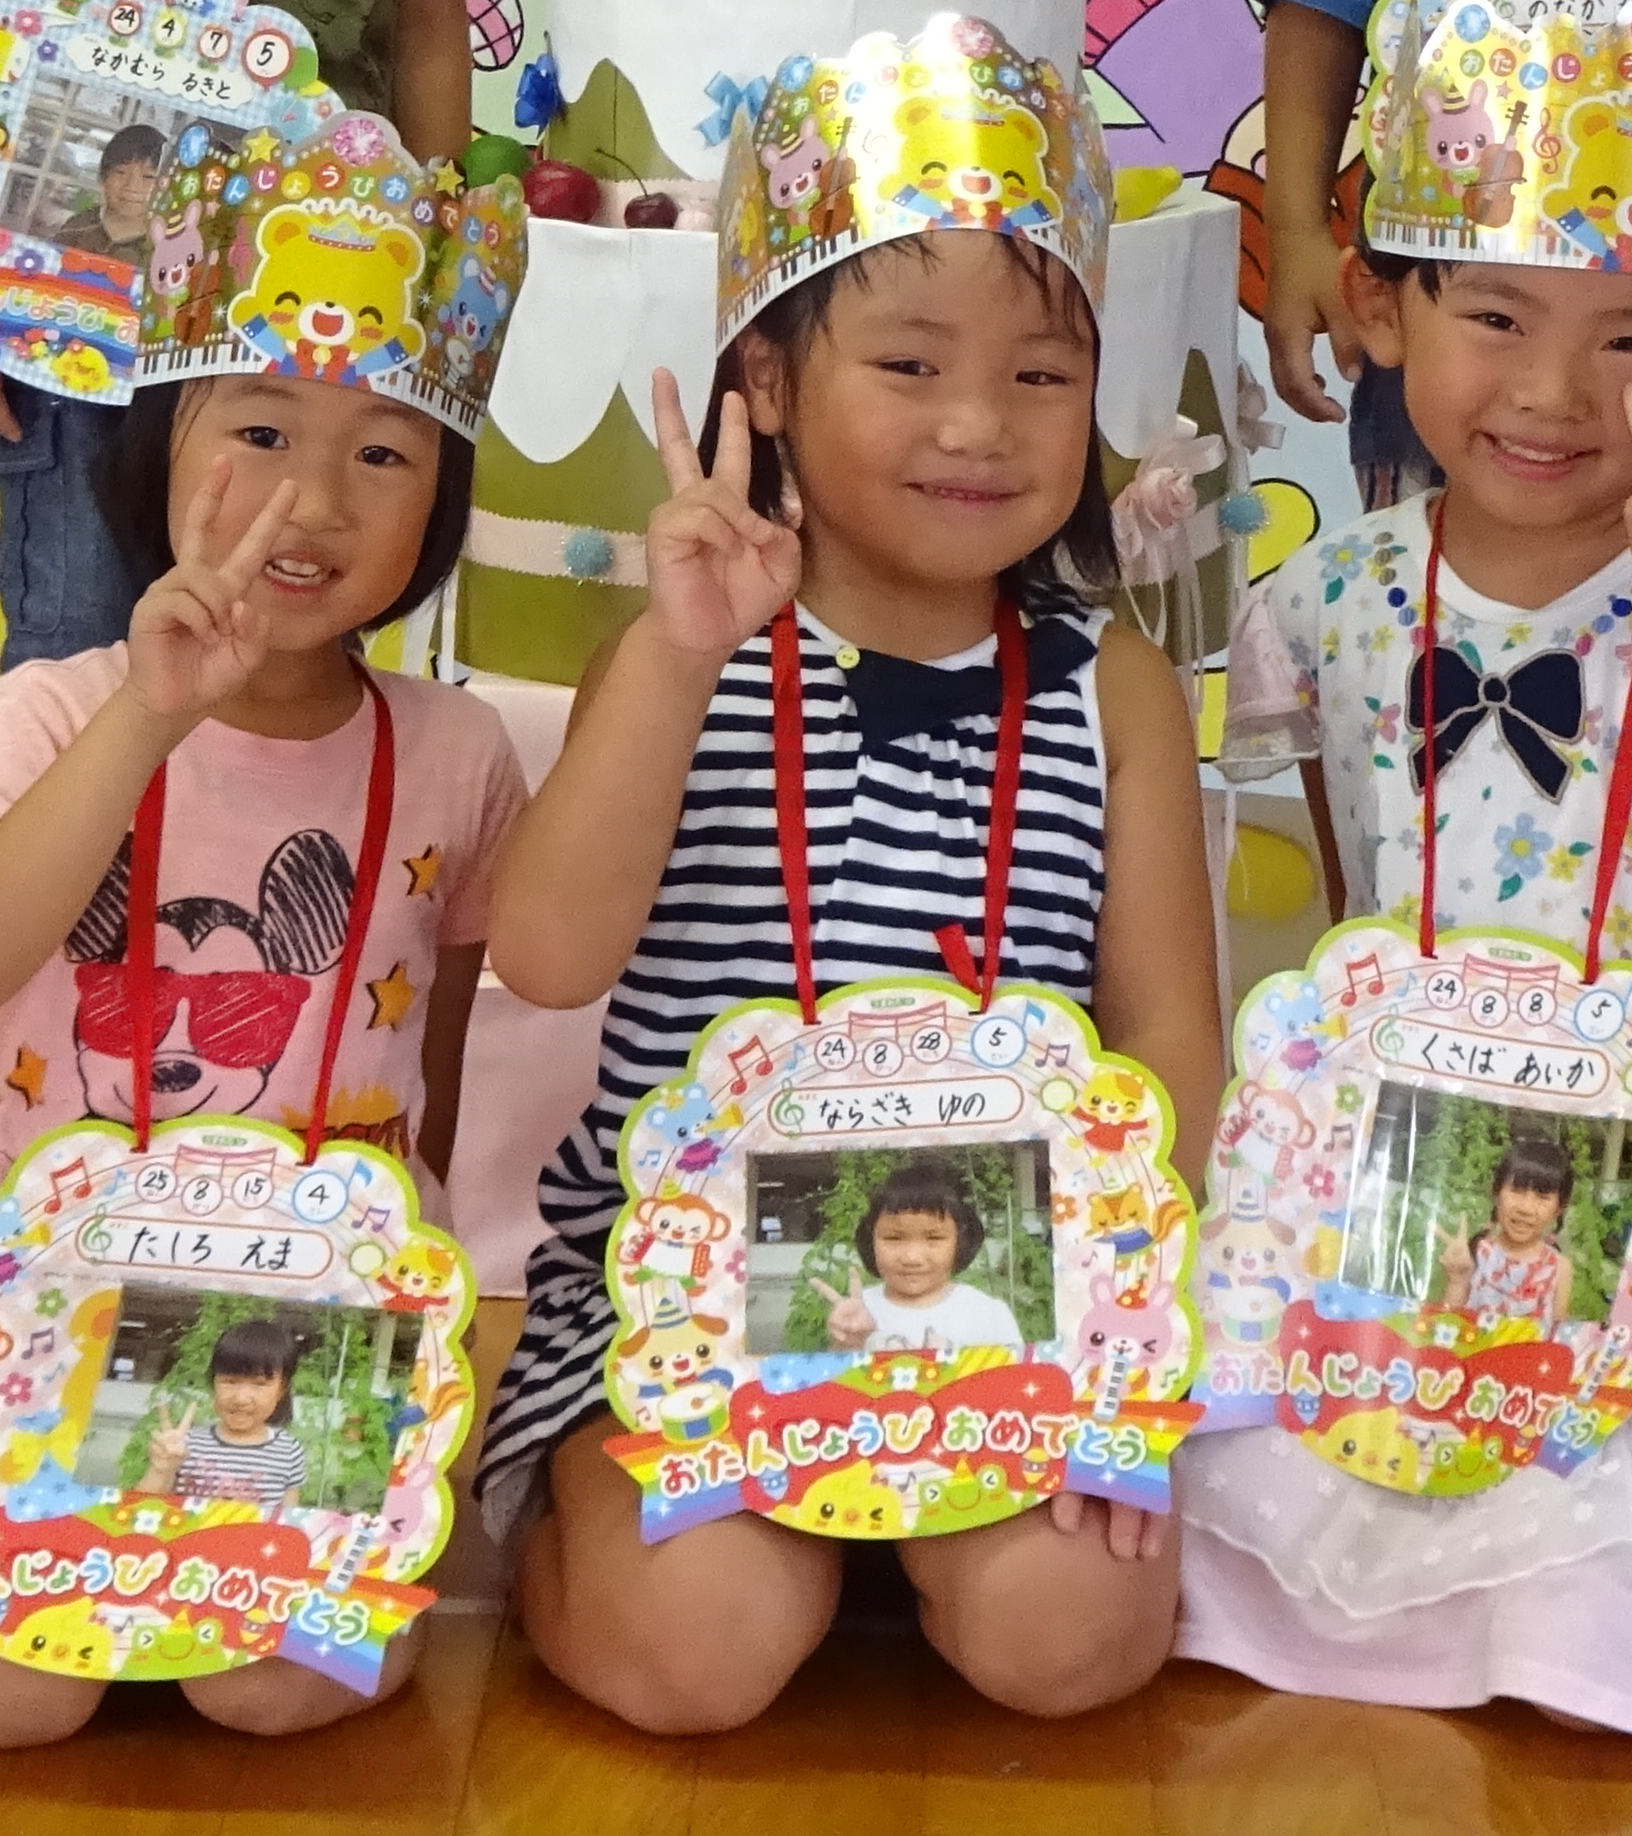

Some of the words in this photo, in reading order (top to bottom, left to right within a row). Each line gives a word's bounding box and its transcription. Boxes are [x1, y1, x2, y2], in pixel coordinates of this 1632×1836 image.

[114, 7, 136, 27] 24
[161, 19, 175, 37] 4
[209, 31, 223, 51] 7
[256, 41, 276, 67] 5
[91, 46, 166, 81] なかむら
[1433, 979, 1456, 999] 24
[1481, 996, 1496, 1013] 8
[1529, 993, 1544, 1011] 8
[1591, 999, 1611, 1018] 5
[821, 1038, 848, 1058] 24
[873, 1044, 888, 1064] 8
[988, 1027, 1006, 1046] 5
[1421, 1033, 1507, 1074] くさば
[1514, 1052, 1595, 1090] あいか
[819, 1092, 913, 1128] ならざき
[938, 1093, 985, 1127] ゆの
[145, 1171, 169, 1191] 25
[193, 1182, 210, 1200] 8
[244, 1178, 266, 1197] 15
[308, 1184, 330, 1205] 4
[239, 1236, 293, 1271] えま
[659, 1406, 934, 1499] おたんじょうび
[941, 1410, 1148, 1469] おめでとう
[170, 1557, 371, 1645] おめでとう
